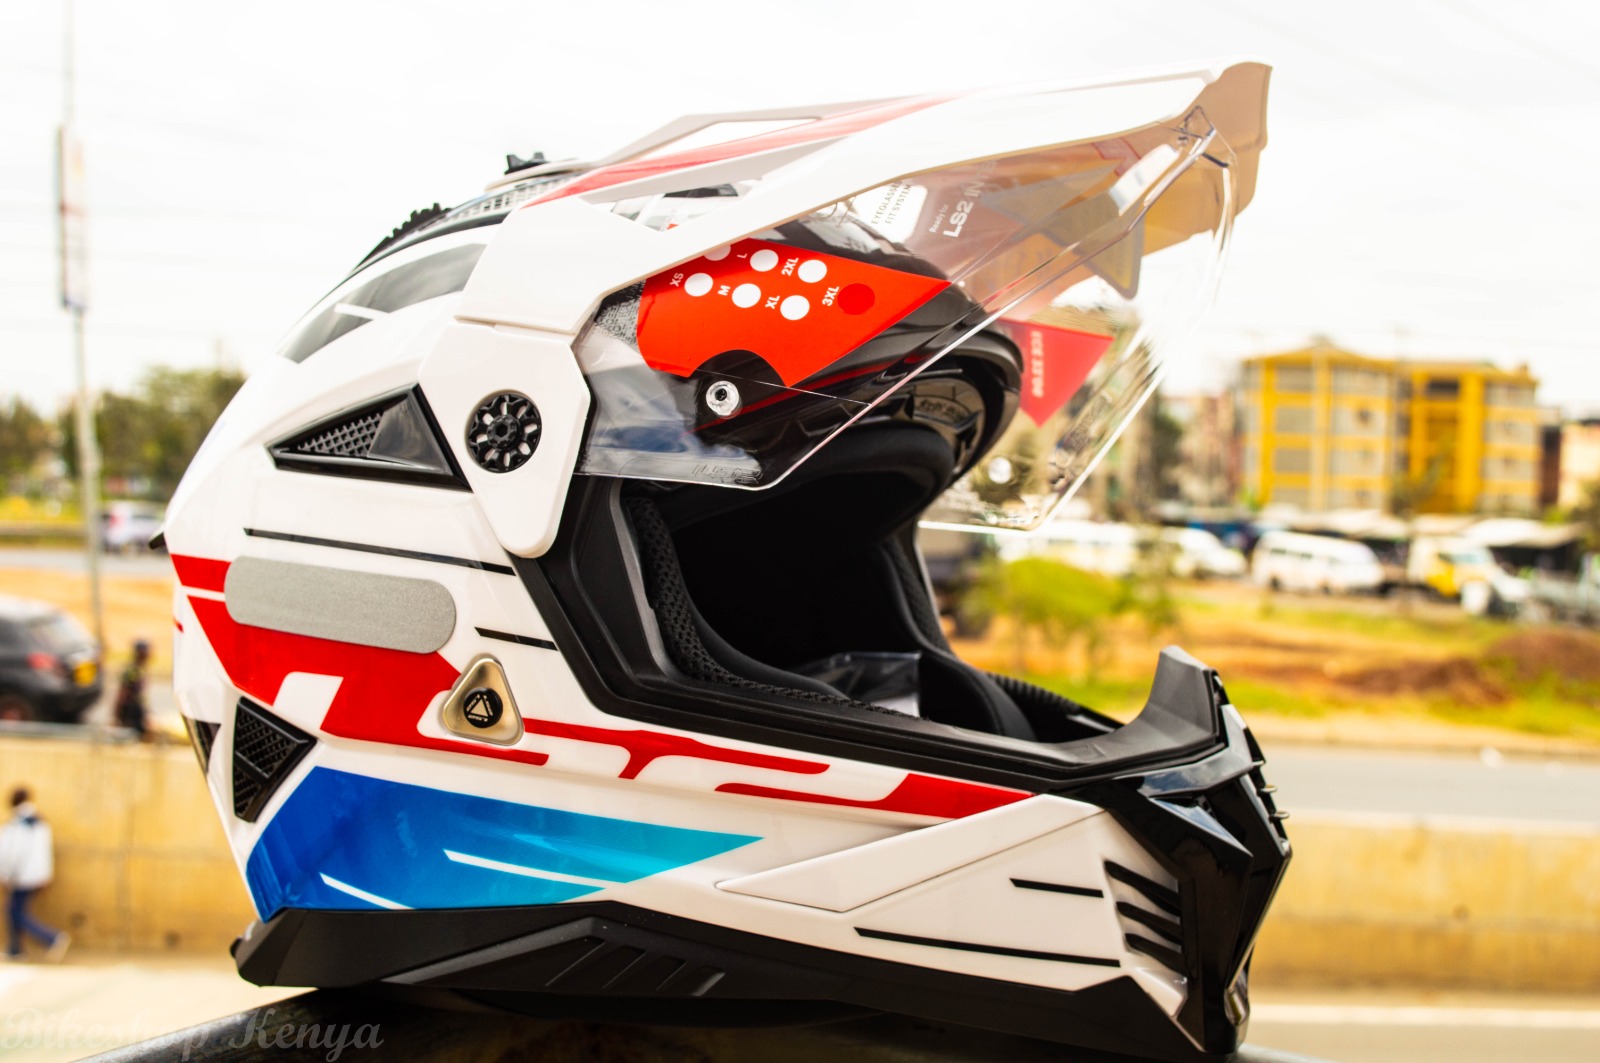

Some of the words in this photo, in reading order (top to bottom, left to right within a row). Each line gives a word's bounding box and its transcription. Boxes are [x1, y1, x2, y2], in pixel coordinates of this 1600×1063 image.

[885, 212, 896, 224] FIT
[892, 184, 911, 210] SYSTEM
[929, 213, 946, 233] Ready
[943, 200, 974, 237] LS2
[736, 252, 748, 260] L
[781, 256, 799, 277] 2XL
[669, 272, 684, 287] XS
[717, 284, 731, 296] M
[821, 285, 840, 307] 3XL
[764, 293, 780, 309] XL
